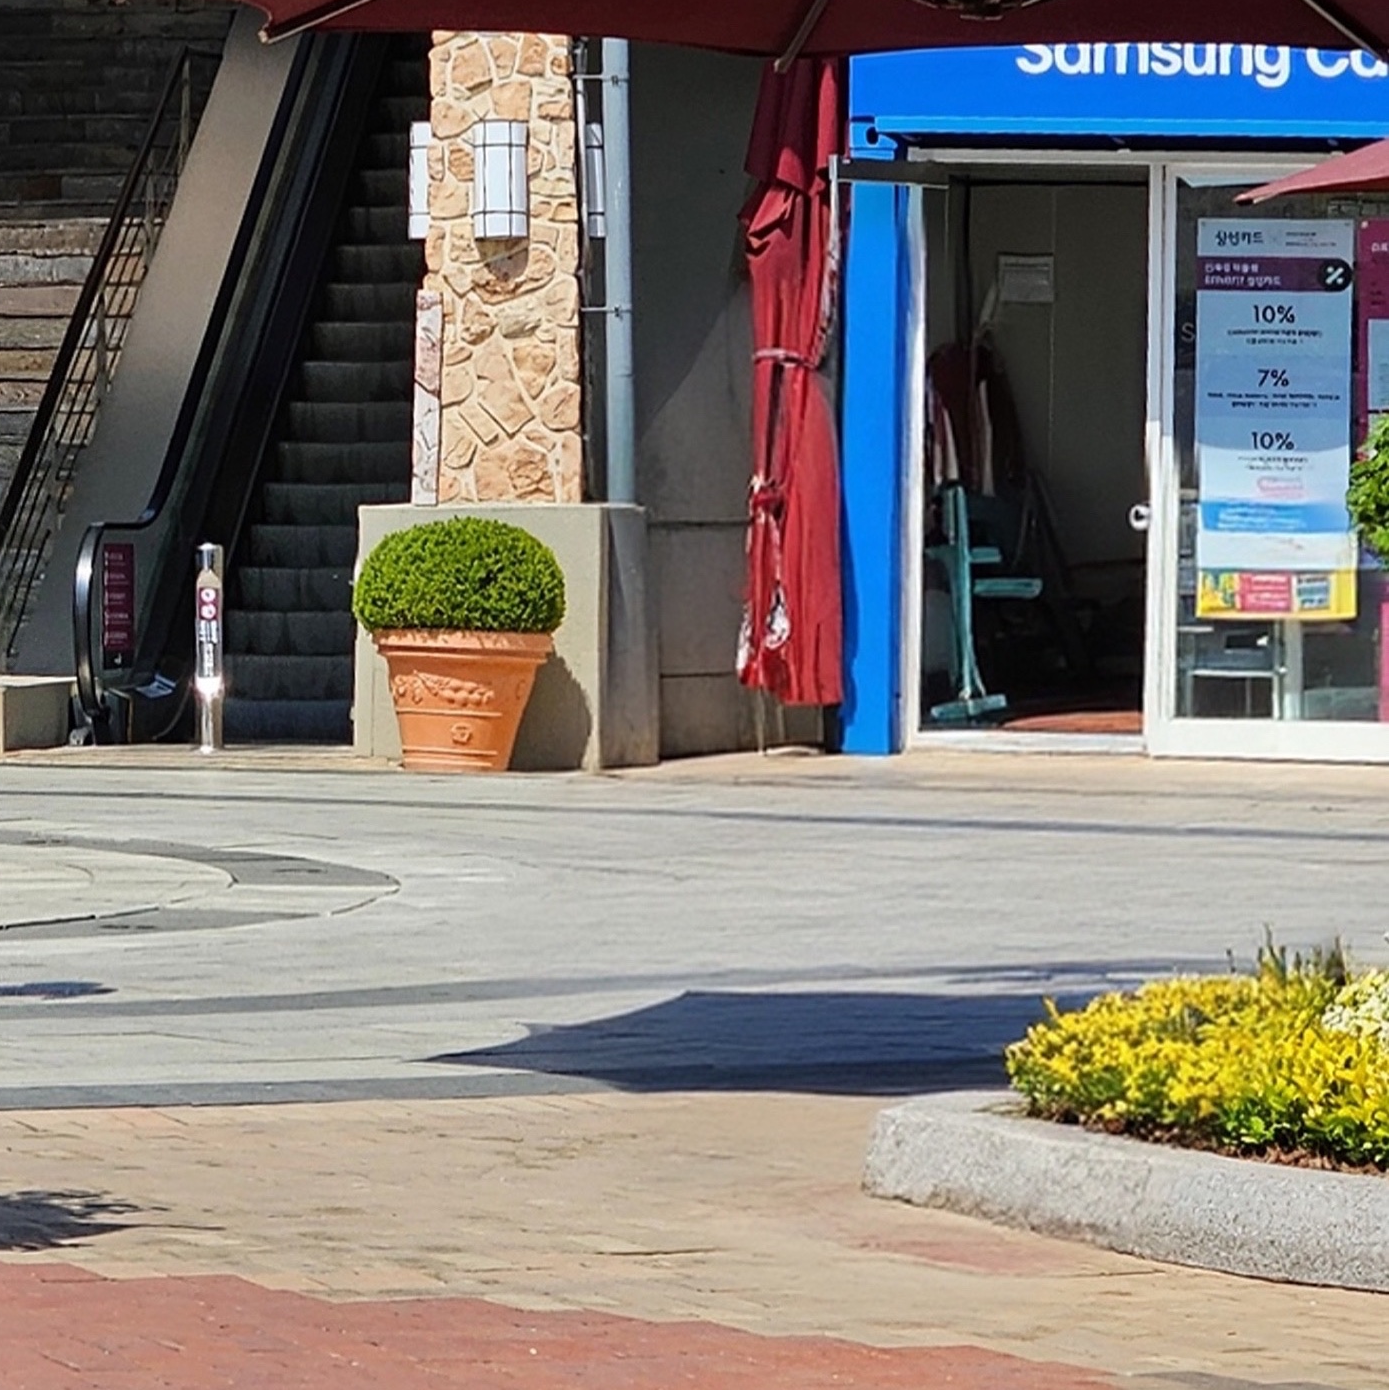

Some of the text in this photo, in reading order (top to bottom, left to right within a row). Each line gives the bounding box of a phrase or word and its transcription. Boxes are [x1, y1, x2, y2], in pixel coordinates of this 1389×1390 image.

[1015, 42, 1291, 88] Samsung
[1253, 305, 1296, 324] 10%
[1257, 369, 1290, 388] 7%
[1251, 431, 1295, 450] 10%
